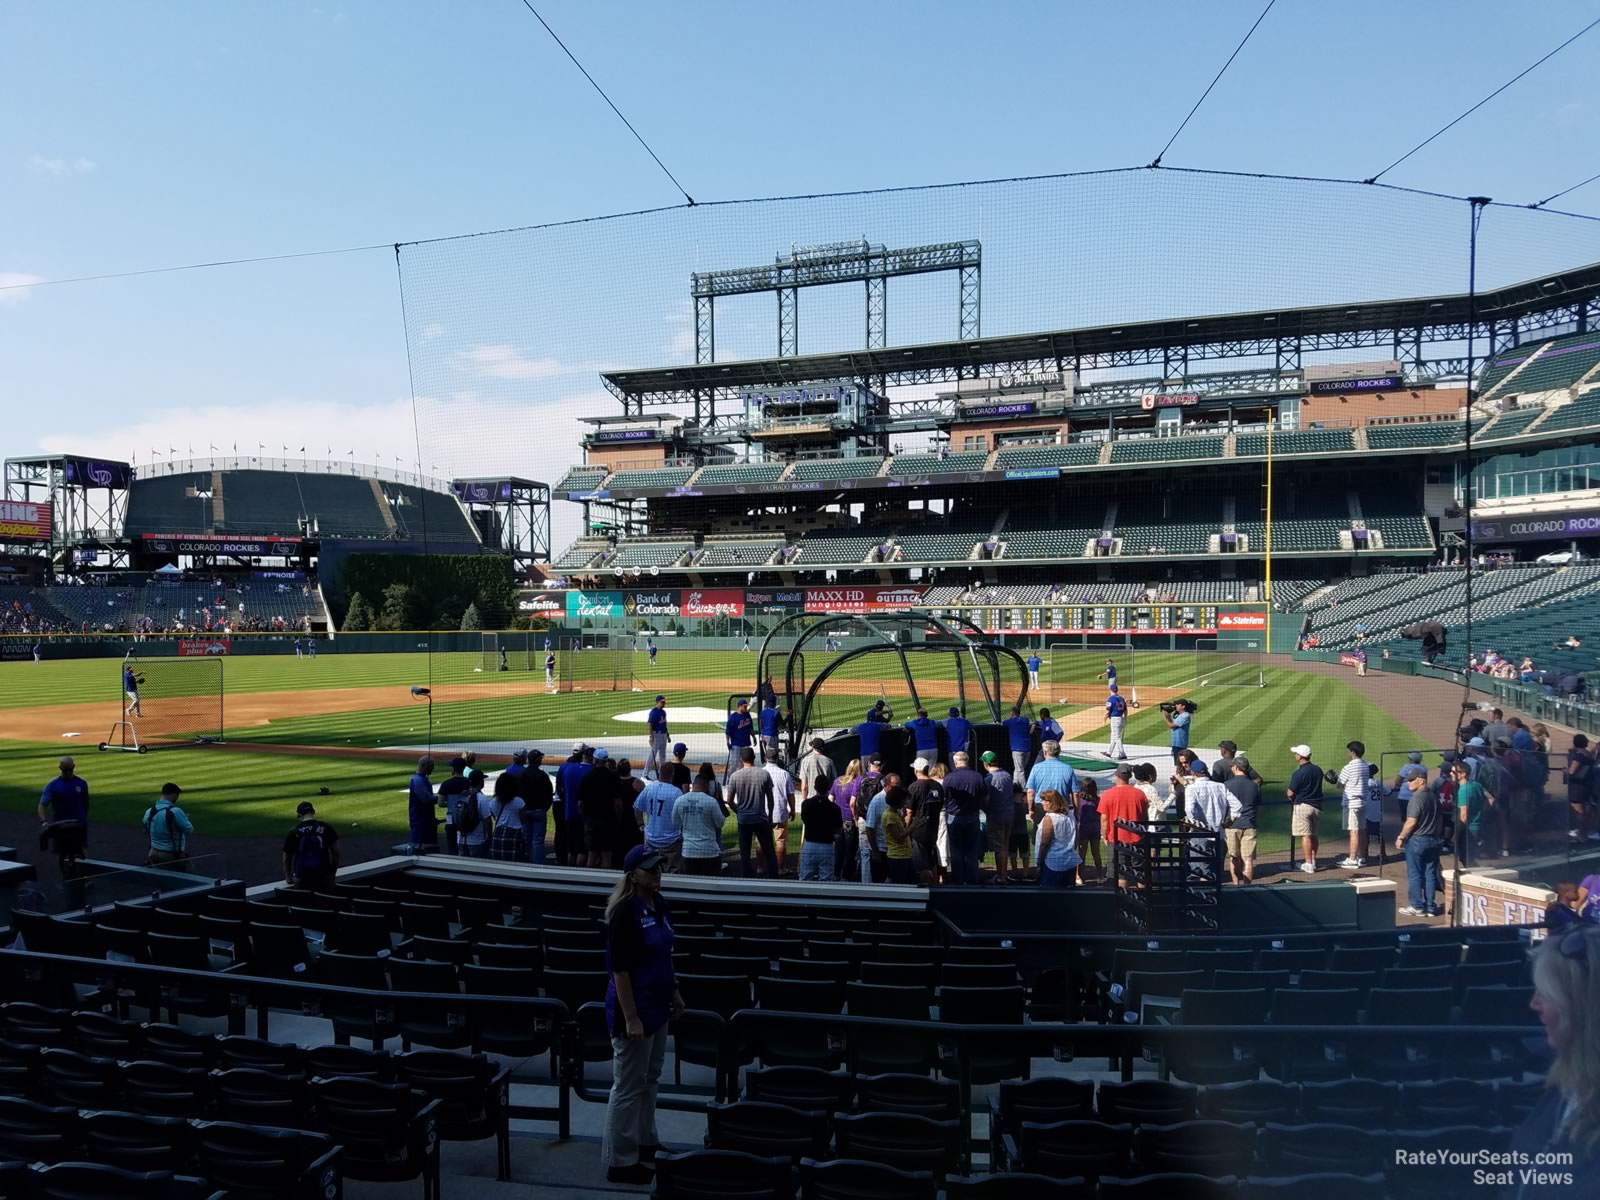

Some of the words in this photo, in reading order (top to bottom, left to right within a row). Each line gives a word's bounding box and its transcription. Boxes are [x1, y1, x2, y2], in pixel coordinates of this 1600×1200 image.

[1014, 374, 1031, 384] JACK
[1034, 371, 1060, 382] DANIEL'S
[1318, 381, 1355, 391] COLORADO
[1357, 378, 1391, 388] ROCKIES
[965, 407, 997, 416] COLORADO
[998, 404, 1027, 413] ROCKIES
[600, 432, 625, 441] COLORADO
[625, 431, 648, 440] ROCKIES
[1006, 470, 1059, 479] OfficeLiquidators.com
[760, 483, 790, 492] COLORADO
[791, 481, 820, 490] ROCKIES
[1510, 519, 1566, 534] COLORADO
[179, 543, 221, 552] COLORADO
[223, 544, 260, 552] ROCKIES
[636, 593, 660, 604] Bank
[660, 592, 671, 603] of
[807, 591, 845, 601] MAXX
[846, 591, 865, 601] HD
[519, 601, 560, 610] Safelite
[576, 601, 613, 616] dental
[636, 603, 680, 614] Colorado
[807, 601, 864, 609] sunglasses
[186, 648, 204, 656] plus
[649, 798, 665, 817] 17
[1479, 881, 1519, 895] ROCKIES.COM
